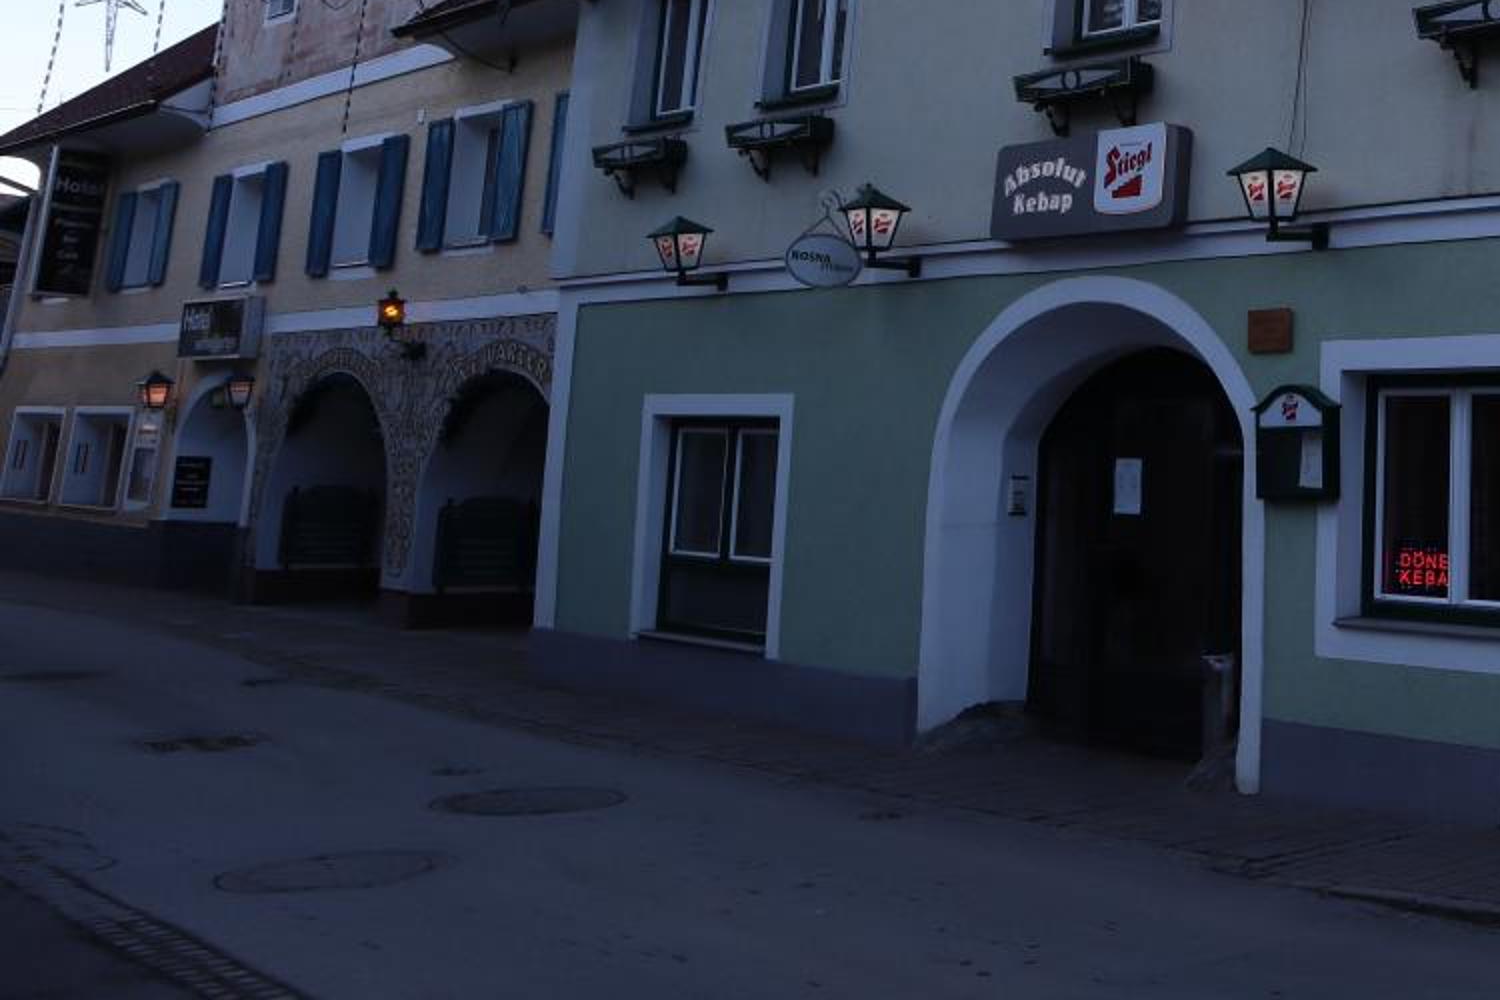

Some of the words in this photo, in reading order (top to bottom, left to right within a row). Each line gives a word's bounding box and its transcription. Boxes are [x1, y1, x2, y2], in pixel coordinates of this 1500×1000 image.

[1004, 157, 1088, 198] Absolut
[1103, 141, 1153, 189] Stiegl
[1013, 190, 1073, 216] Kebap
